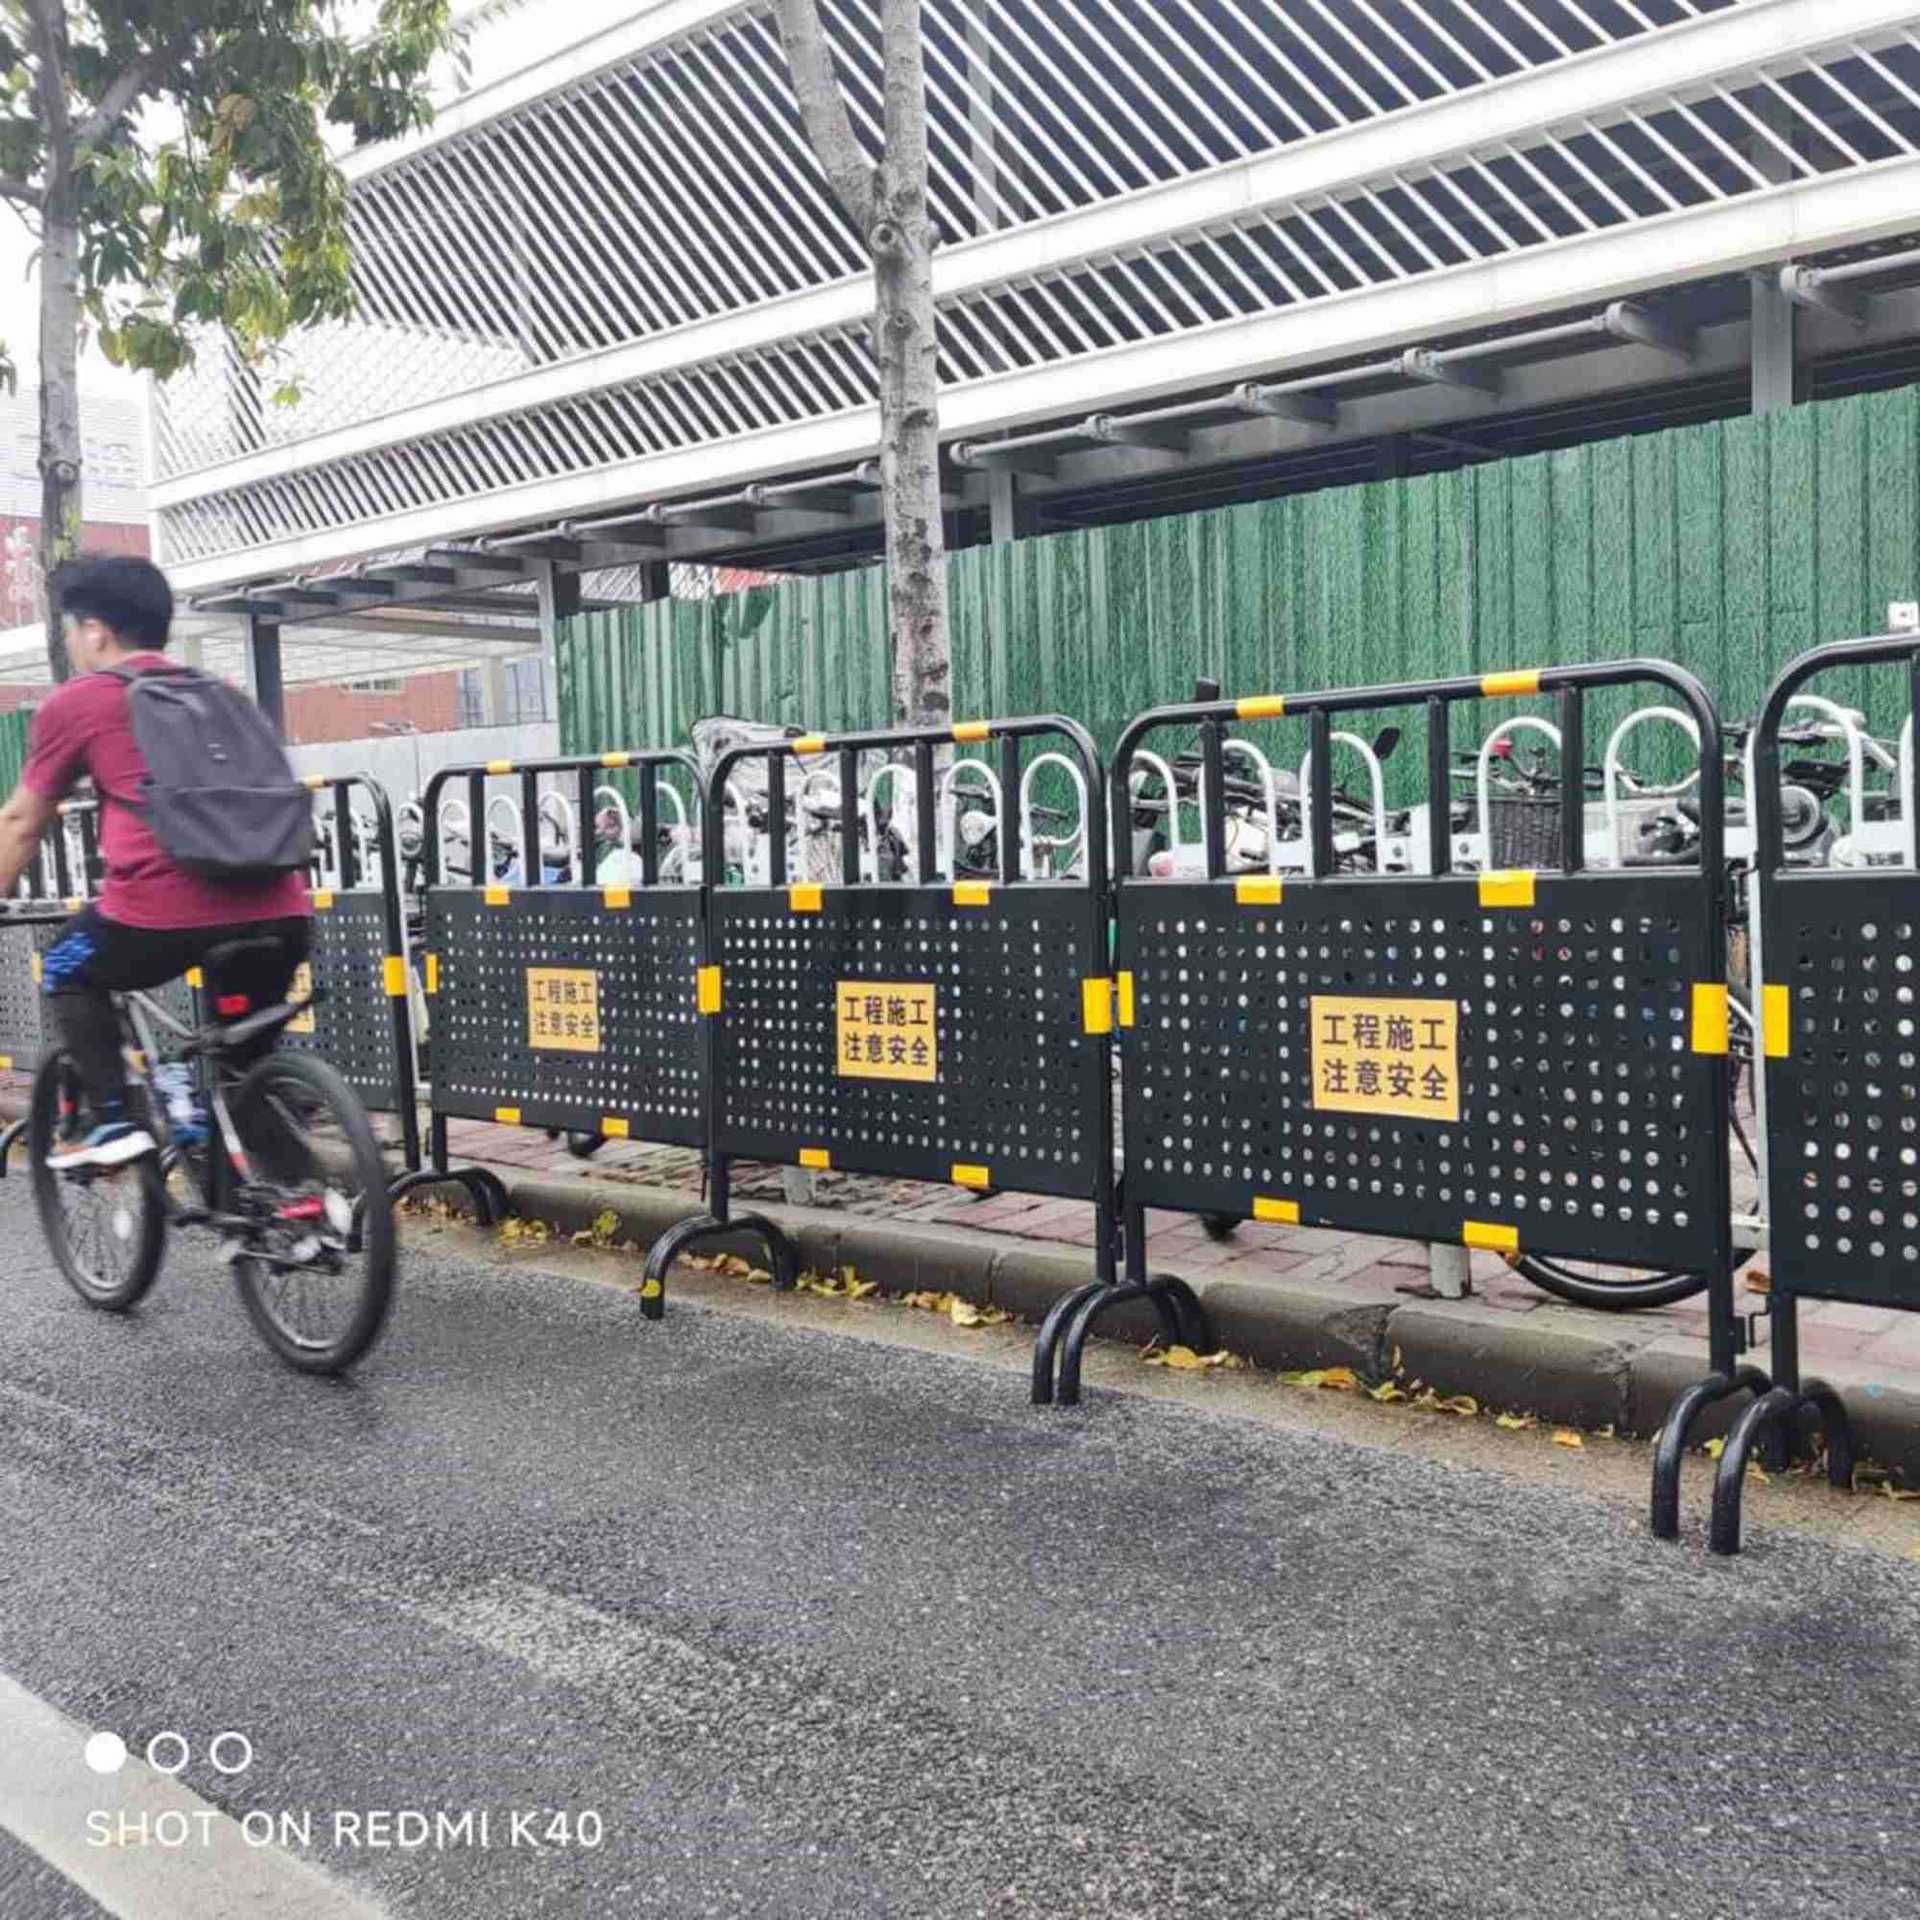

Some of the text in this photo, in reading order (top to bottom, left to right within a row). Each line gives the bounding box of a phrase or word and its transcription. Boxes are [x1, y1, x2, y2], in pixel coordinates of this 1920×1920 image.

[843, 995, 929, 1027] 工程施工
[844, 1032, 929, 1067] 注意安全
[1322, 1013, 1448, 1052] 工程施工
[1322, 1058, 1449, 1102] 注意安全
